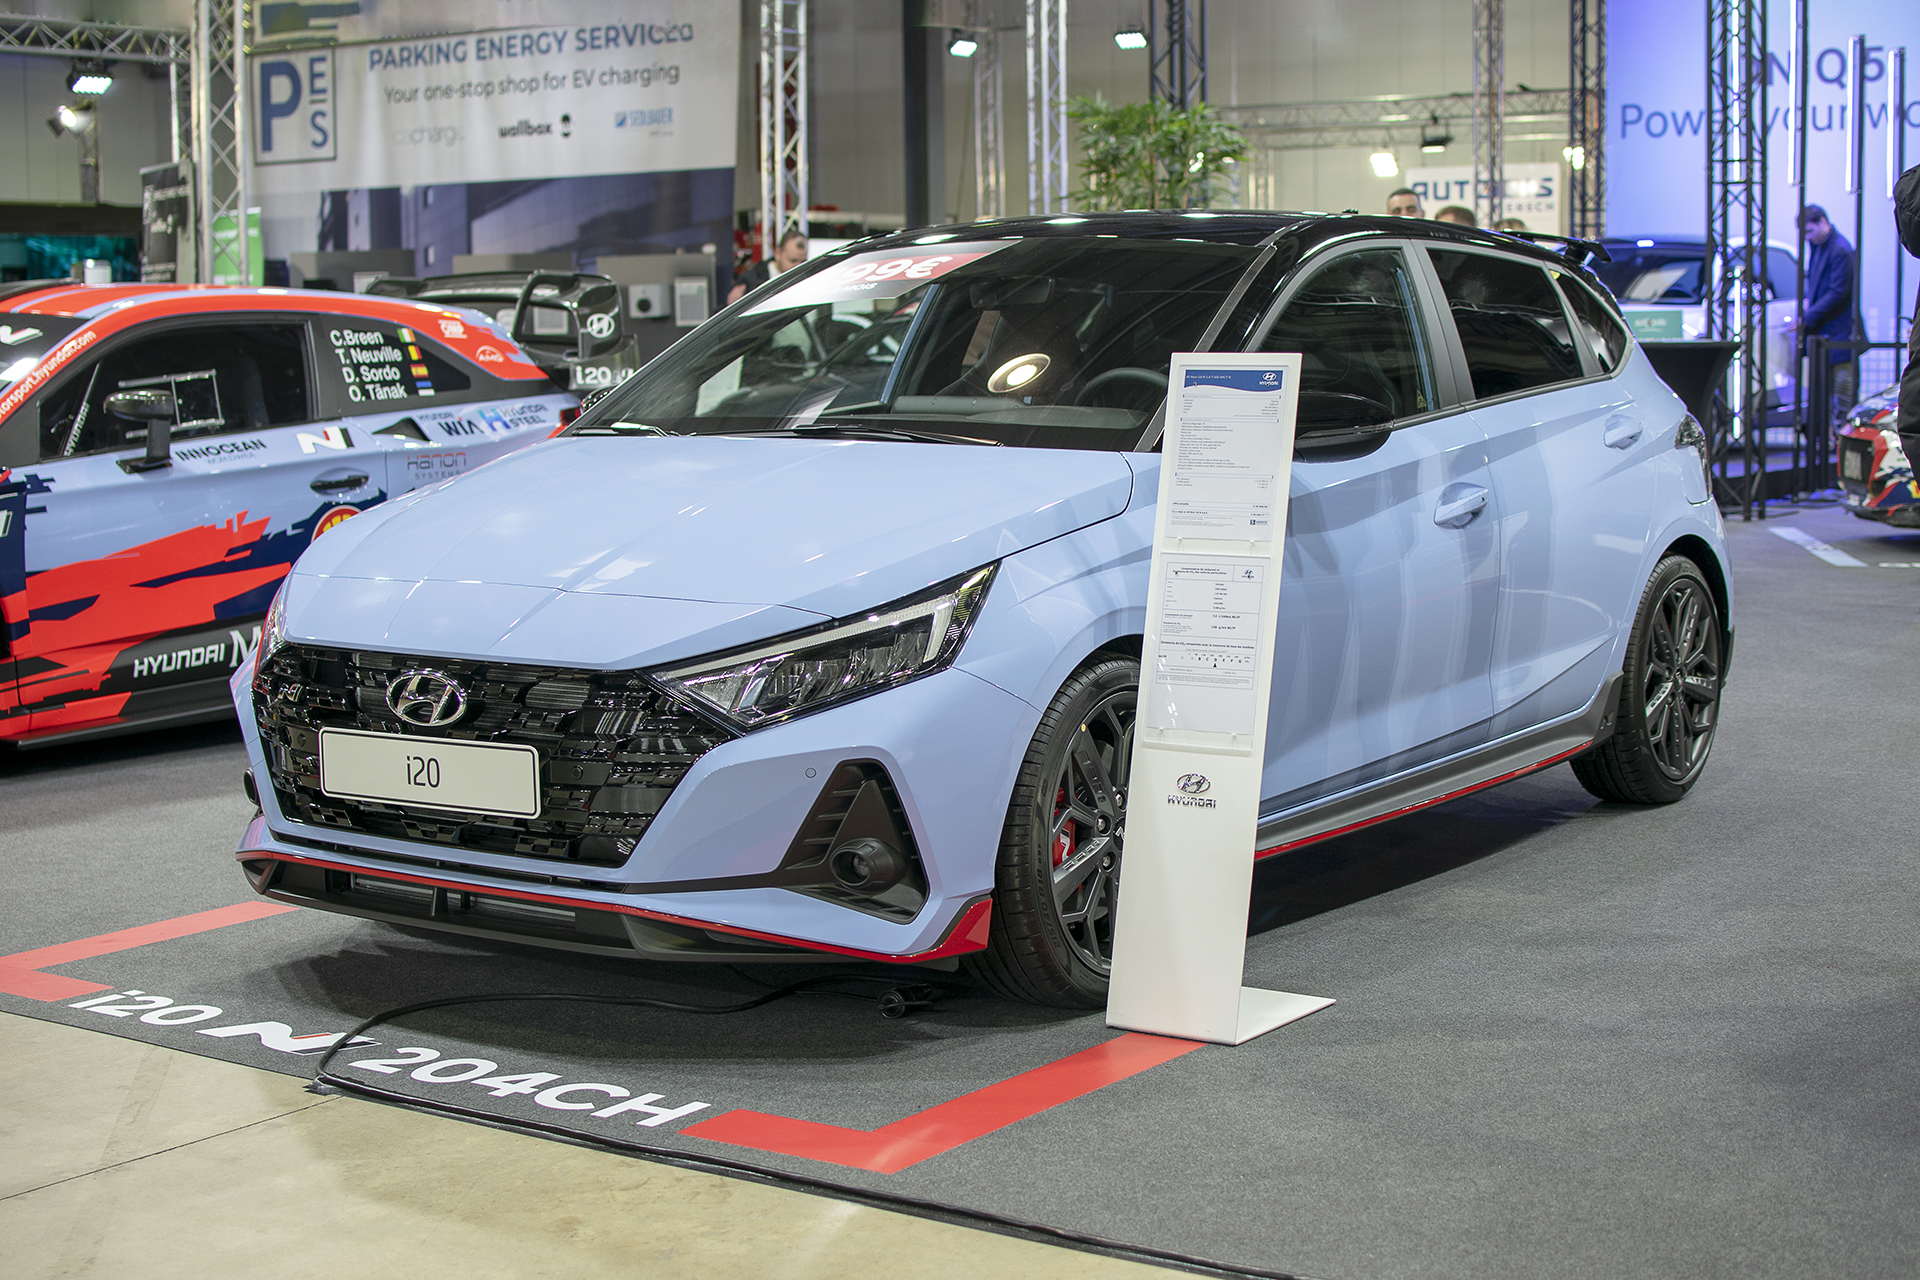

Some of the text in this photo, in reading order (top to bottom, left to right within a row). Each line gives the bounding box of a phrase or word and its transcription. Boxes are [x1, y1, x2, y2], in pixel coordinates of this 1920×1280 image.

[369, 40, 467, 71] PARKING
[476, 31, 568, 60] ENERGY
[383, 62, 681, 103] Your one-stop shop for EV charging
[260, 61, 301, 152] P
[329, 329, 385, 347] C.Breen
[335, 346, 403, 365] T. Neuville
[342, 364, 401, 384] D. Sordo
[576, 365, 613, 385] i20
[348, 385, 367, 402] O.
[501, 403, 549, 418] HYUNDAI
[508, 415, 547, 428] STEEL
[174, 438, 268, 462] INNOCEAN
[133, 642, 226, 679] HYUNDAI
[406, 755, 441, 789] i20
[1167, 794, 1217, 809] HYUNDAI
[67, 989, 224, 1027] i20
[347, 1046, 712, 1128] 204CH
